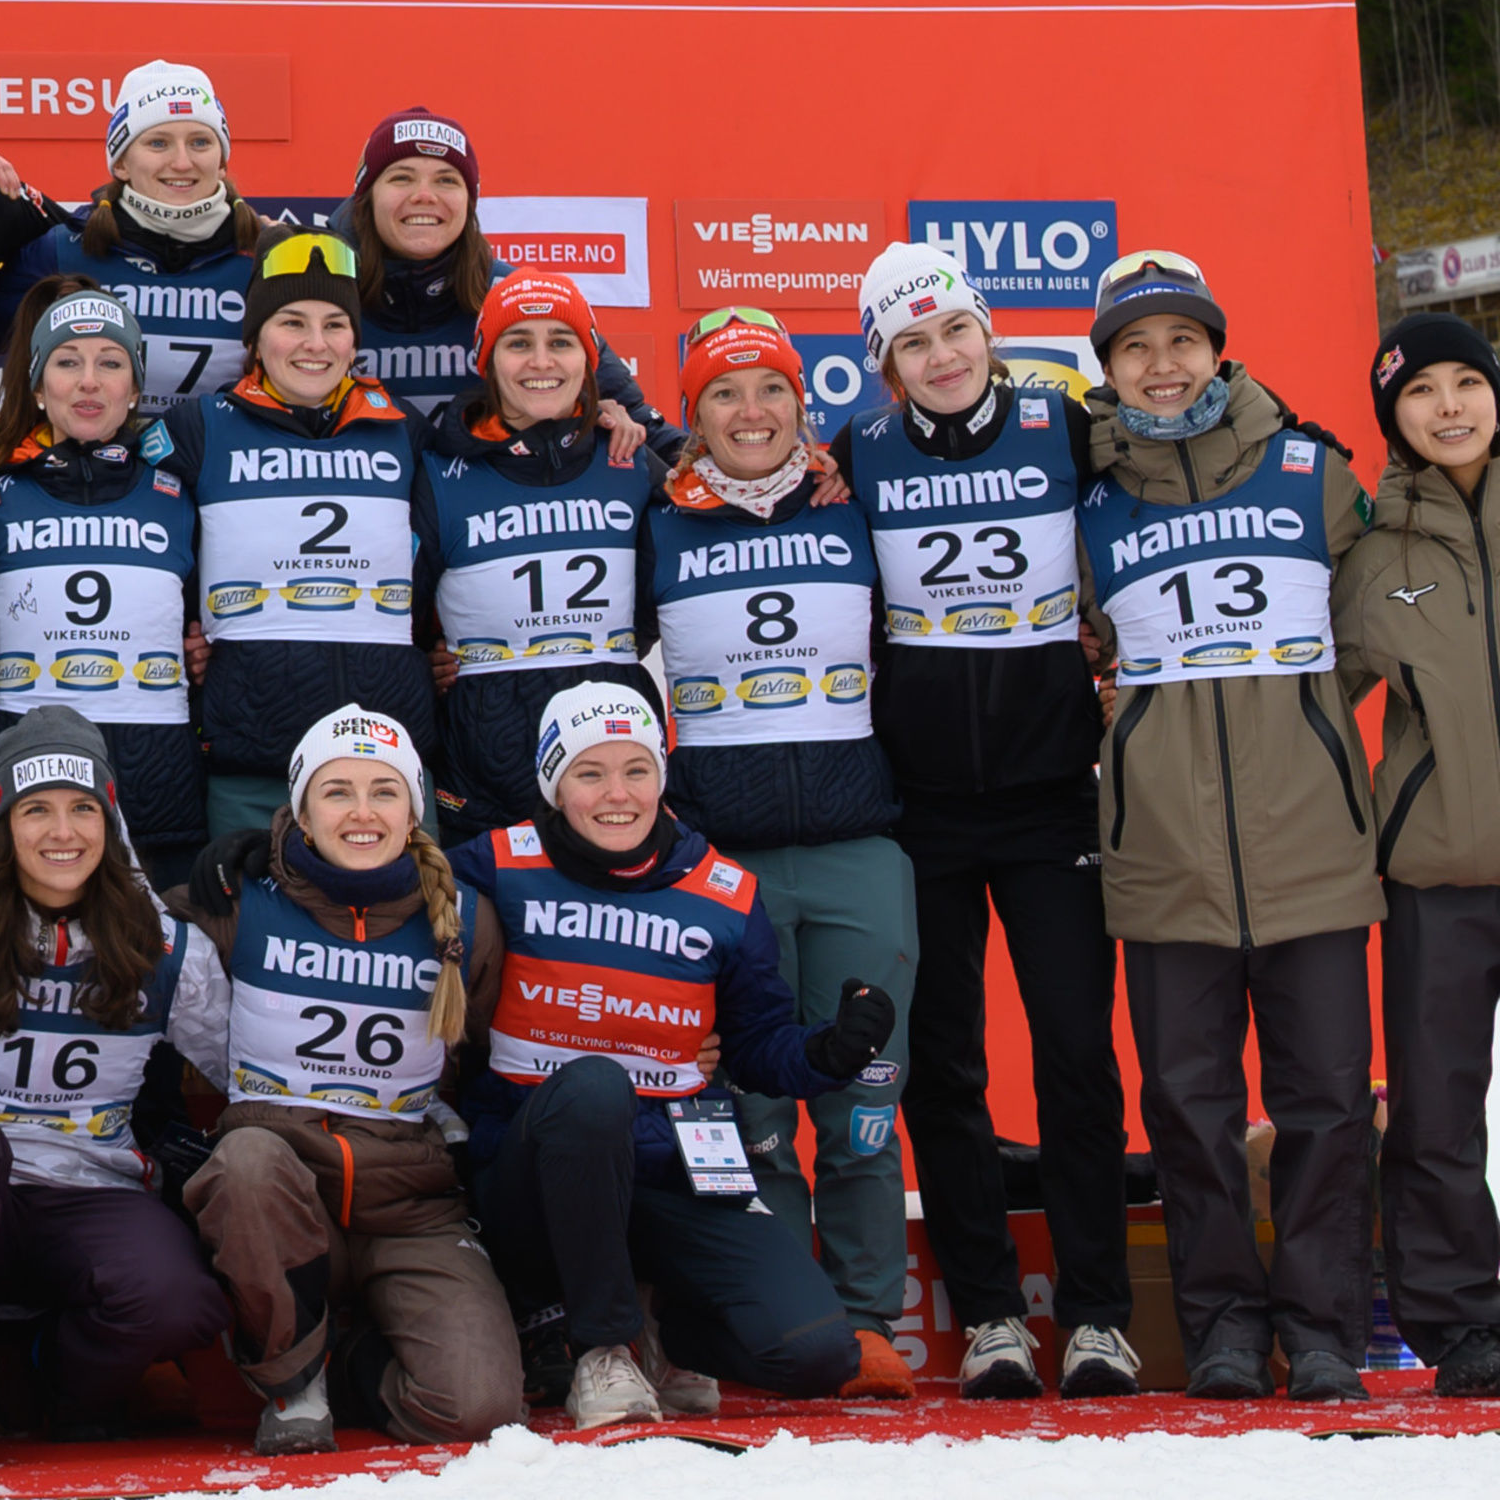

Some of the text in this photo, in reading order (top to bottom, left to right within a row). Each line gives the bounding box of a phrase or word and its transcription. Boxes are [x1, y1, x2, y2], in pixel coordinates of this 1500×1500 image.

[396, 122, 465, 151] BIOTEAQUE
[693, 213, 868, 254] VIESSMANN
[501, 279, 571, 296] VIESSMANN
[698, 268, 864, 293] Wärmepumpen
[1047, 276, 1090, 291] AUGEN
[53, 301, 121, 327] BIOTEAQUE
[100, 284, 246, 323] ammo
[705, 328, 778, 348] VIESSMANN
[229, 448, 402, 483] Nammo
[877, 466, 1049, 512] Nammo
[6, 516, 169, 554] Nammo
[299, 501, 351, 555] 2
[466, 499, 635, 548] Nammo
[1109, 506, 1304, 573] Nammo
[273, 559, 371, 570] VIKERSUND
[678, 533, 852, 582] Nammo
[918, 526, 1029, 587] 23
[65, 570, 112, 626] 9
[513, 554, 610, 613] 12
[927, 582, 1024, 599] VIKERSUND
[1159, 562, 1268, 626] 13
[44, 630, 131, 642] VIKERSUND
[514, 612, 604, 629] VIKERSUND
[746, 591, 799, 646] 8
[1167, 620, 1263, 644] VIKERSUND
[725, 647, 819, 664] VIKERSUND
[332, 717, 399, 737] SVENSKA
[332, 725, 368, 739] SPEL
[17, 758, 91, 785] BIOTEAQUE
[524, 899, 713, 961] Nammo
[518, 980, 701, 1027] VIESSMANN
[295, 1005, 405, 1067] 26
[530, 1028, 681, 1060] FIS SKI FLYING WORLD CUP
[3, 1036, 100, 1091] 16
[300, 1061, 393, 1080] VIKERSUND
